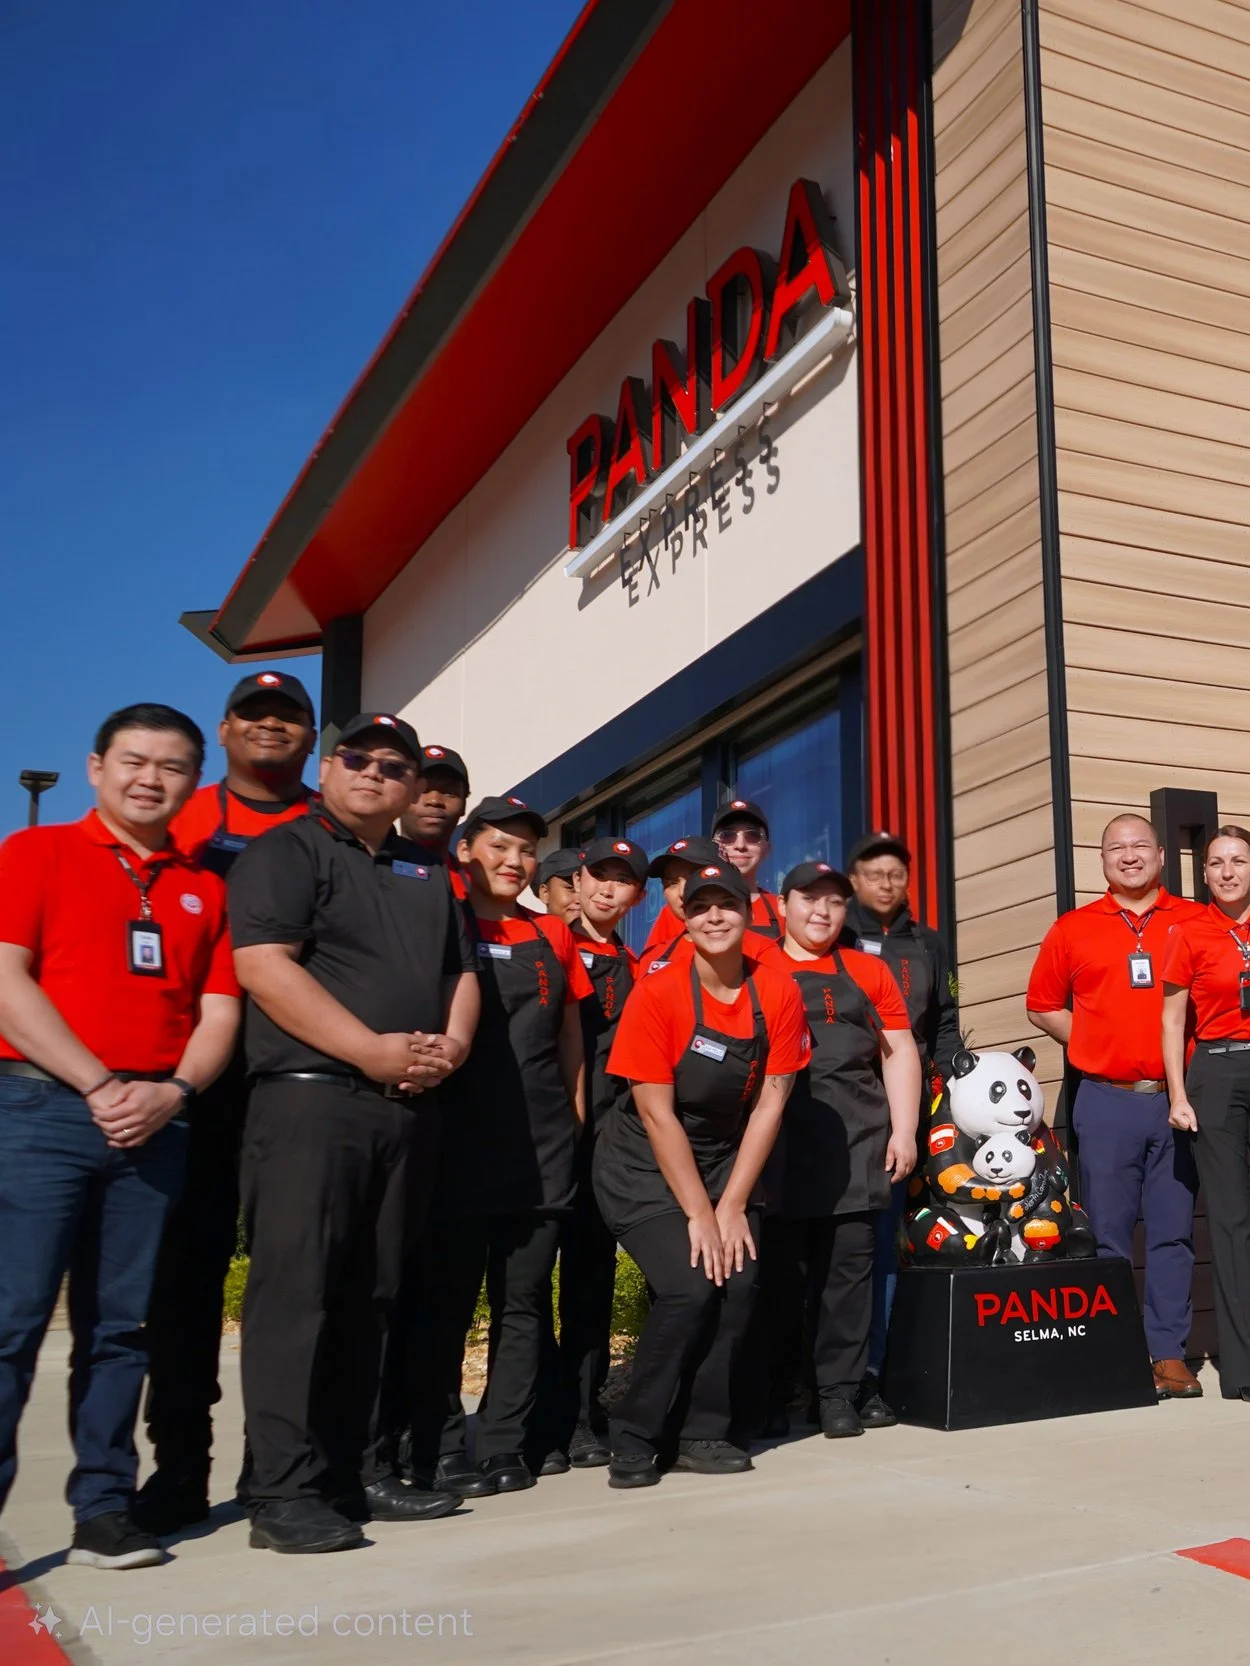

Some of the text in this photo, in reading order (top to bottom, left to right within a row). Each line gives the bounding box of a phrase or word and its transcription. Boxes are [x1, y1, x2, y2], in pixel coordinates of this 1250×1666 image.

[567, 178, 836, 552] PANDA
[620, 416, 773, 589] EXPRESS
[822, 988, 835, 1024] PANDA
[741, 1060, 759, 1100] PAN
[974, 1284, 1118, 1327] PANDA
[1014, 1325, 1086, 1342] SELMA, NC
